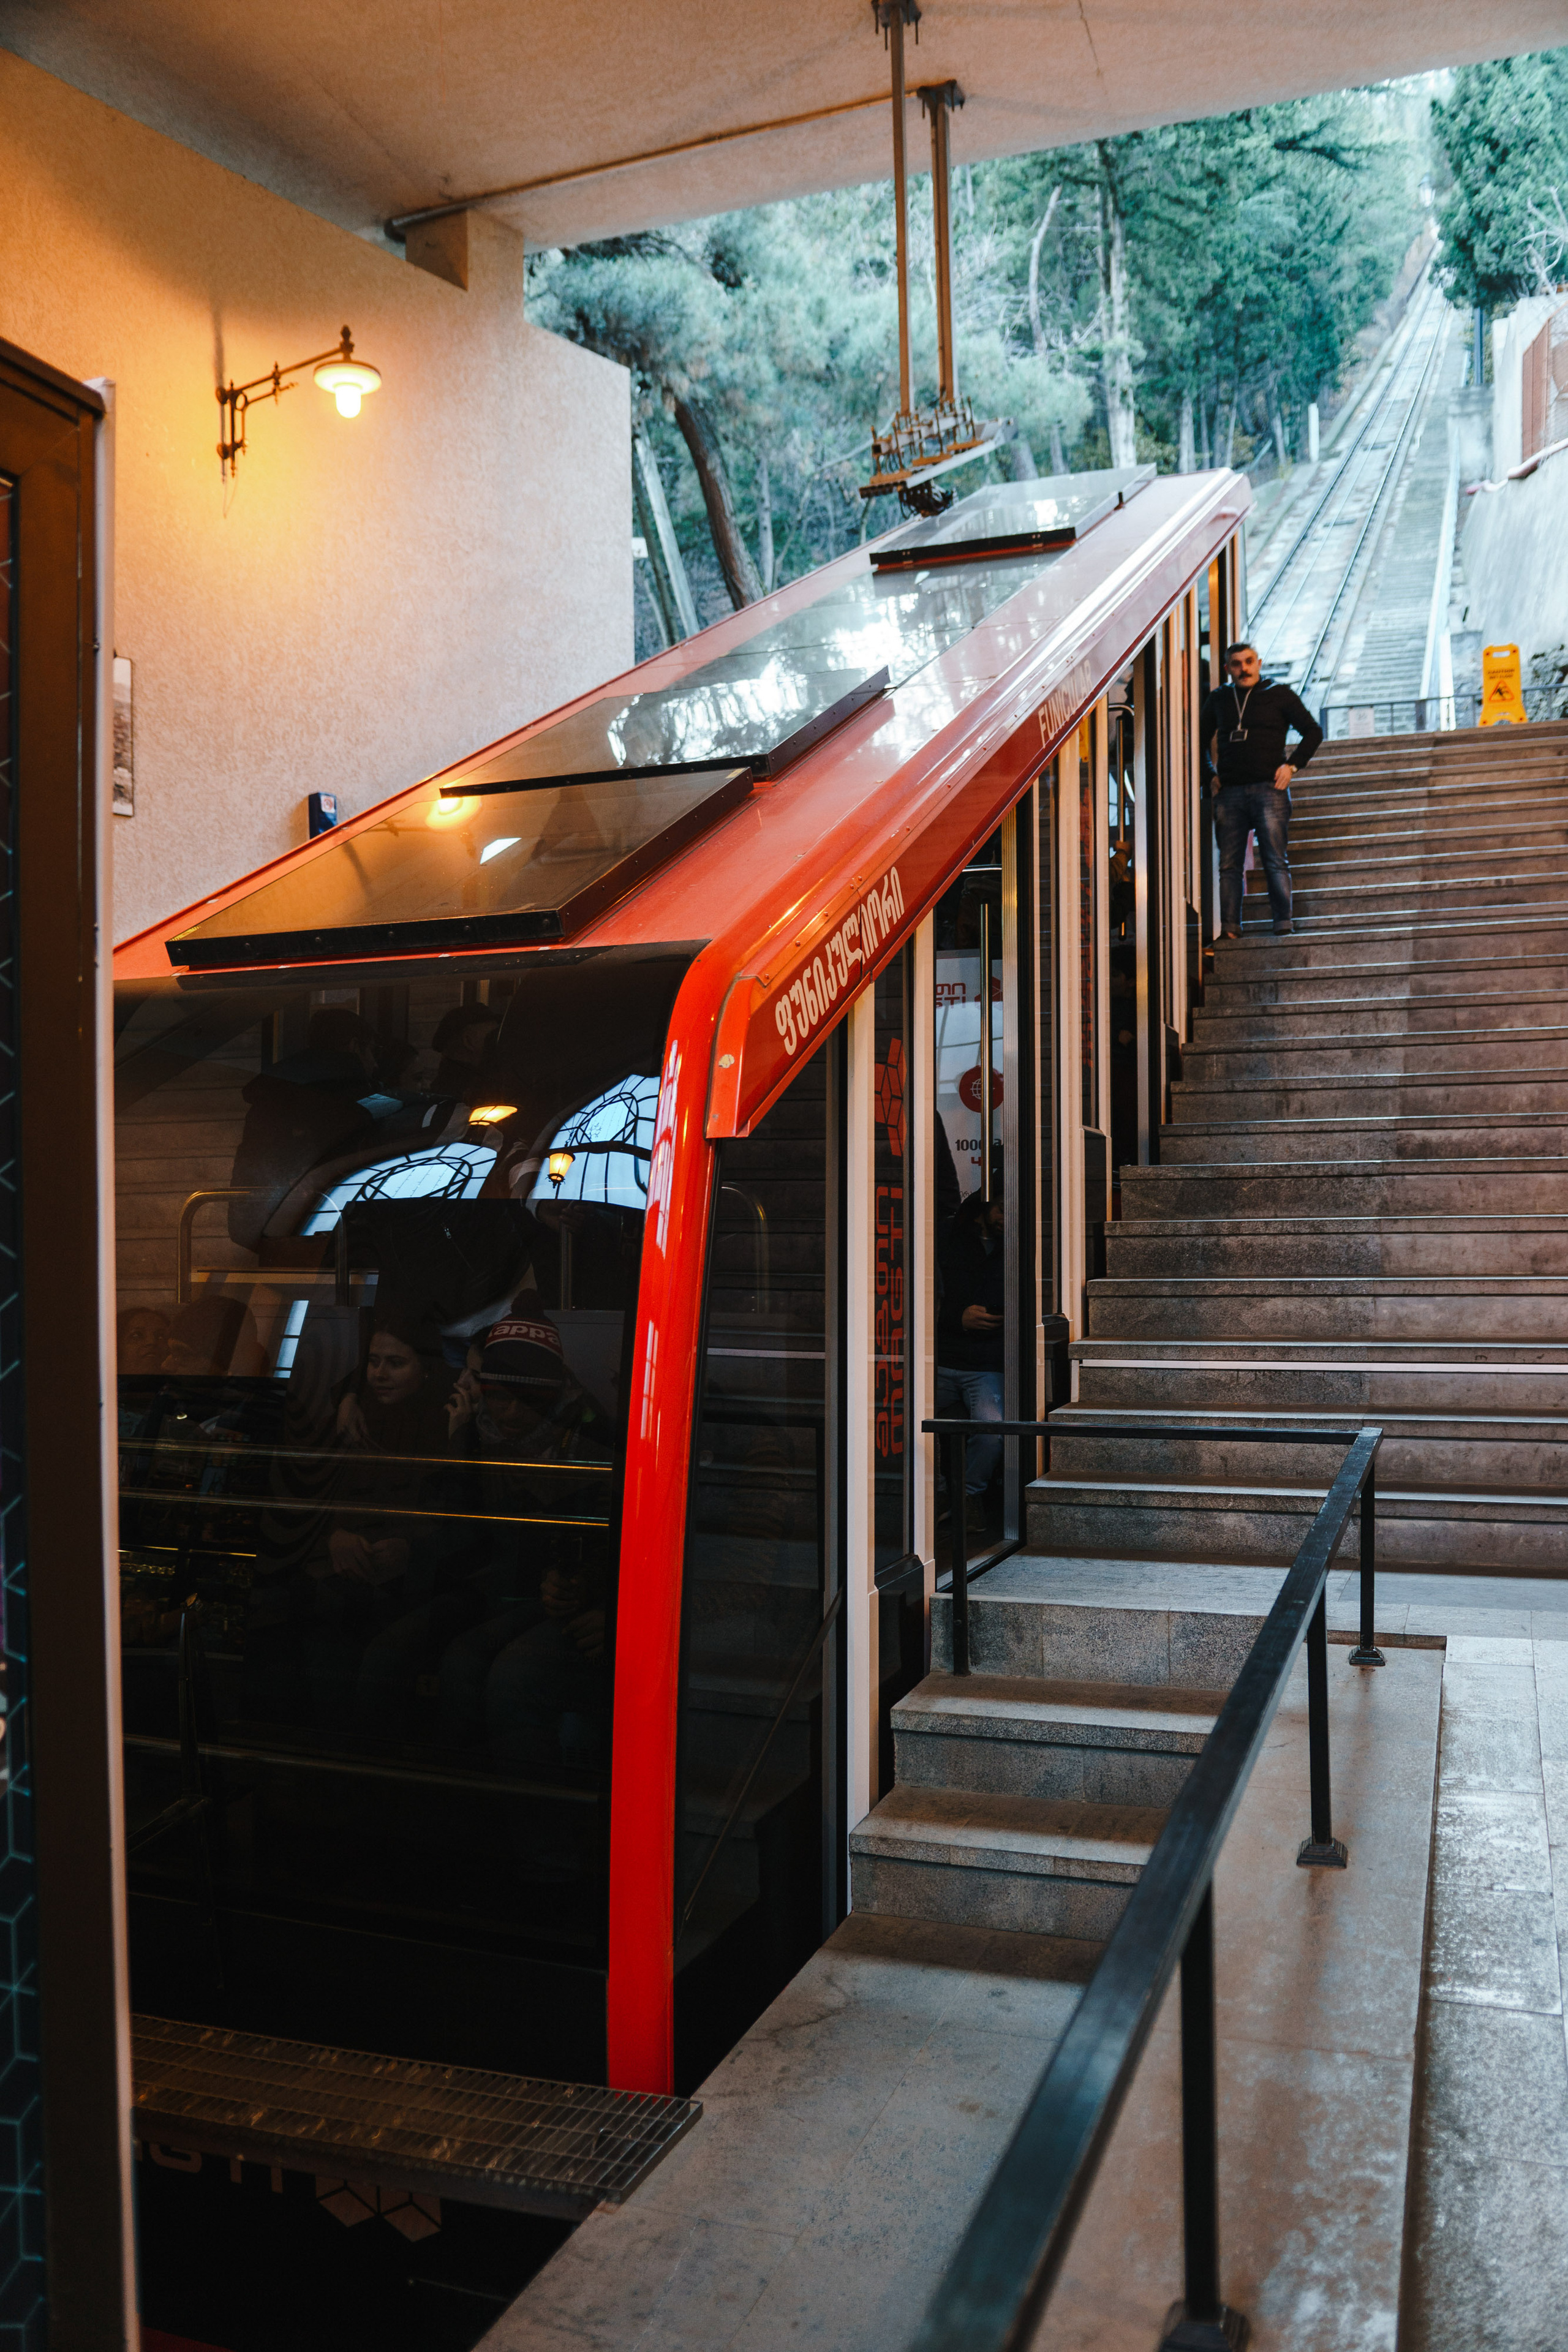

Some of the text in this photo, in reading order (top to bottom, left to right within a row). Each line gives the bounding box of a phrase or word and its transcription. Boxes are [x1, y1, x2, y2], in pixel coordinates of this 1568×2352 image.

[1038, 659, 1095, 748] FUNICULAR
[775, 866, 905, 1056] ფუნიკულიორი
[488, 1325, 561, 1346] appa
[890, 1188, 903, 1455] MAGTI
